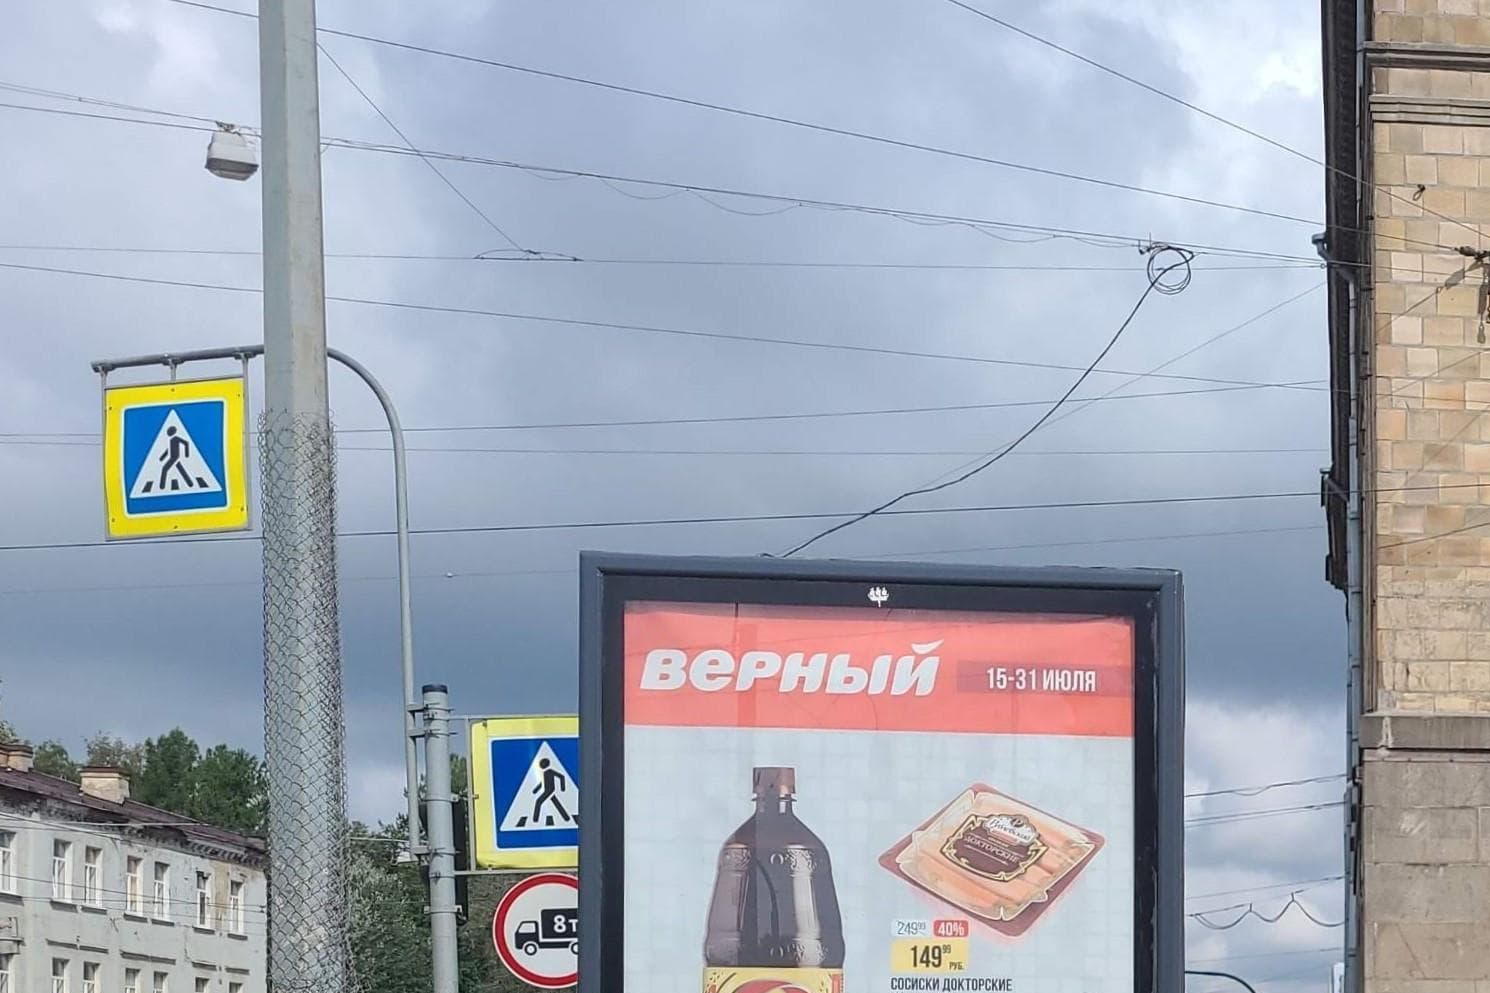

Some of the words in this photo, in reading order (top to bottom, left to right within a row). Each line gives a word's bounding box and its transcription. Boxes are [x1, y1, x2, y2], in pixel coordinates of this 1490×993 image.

[987, 667, 1036, 690] 15-31
[1043, 669, 1096, 692] ИЮЛЯ
[938, 922, 965, 936] 40%
[911, 945, 942, 968] 149
[949, 962, 964, 970] РУБ.
[890, 977, 940, 991] СОСИСКИ
[942, 978, 1013, 992] ДОКТОРСКИЕ
